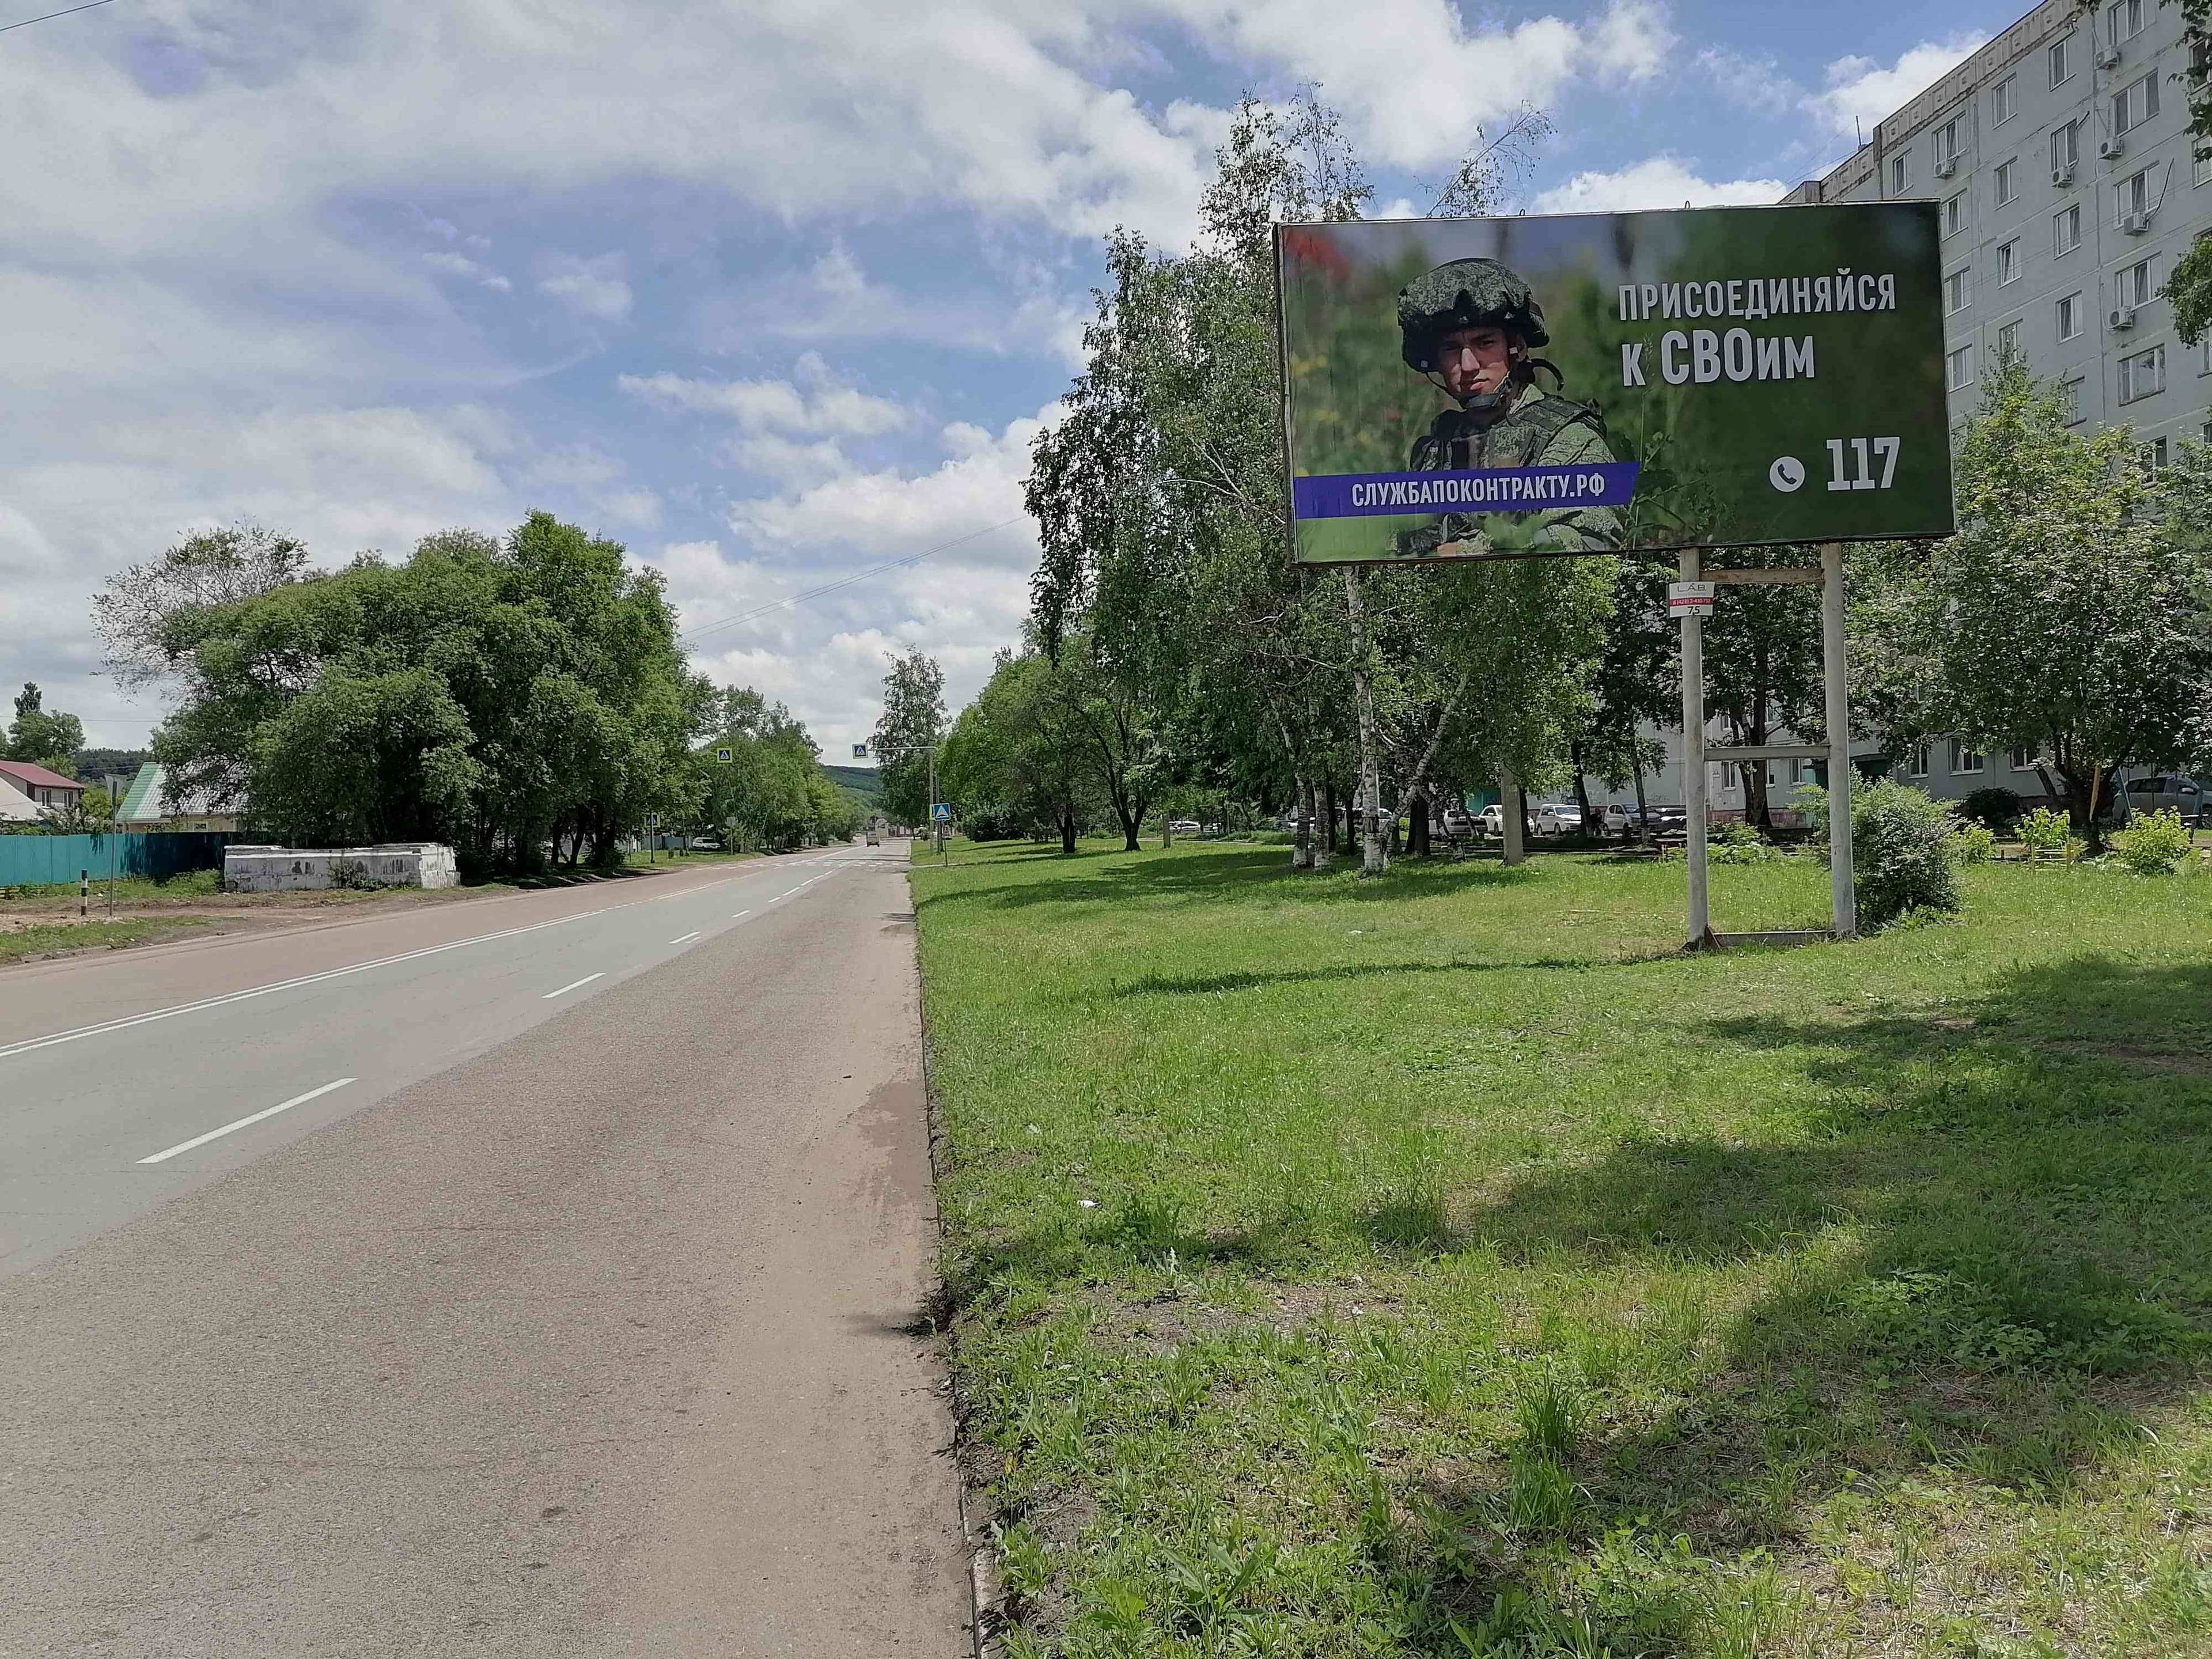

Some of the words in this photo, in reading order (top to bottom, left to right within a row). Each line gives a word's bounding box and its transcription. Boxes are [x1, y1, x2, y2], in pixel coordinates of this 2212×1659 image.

[1618, 267, 1896, 320] ПРИСОЕДИНЯЙСЯ
[1826, 436, 1900, 491] 117
[1351, 472, 1606, 507] СЛУЖБАПОКОНТРАКТУ.РФ
[1687, 605, 1700, 615] 75
